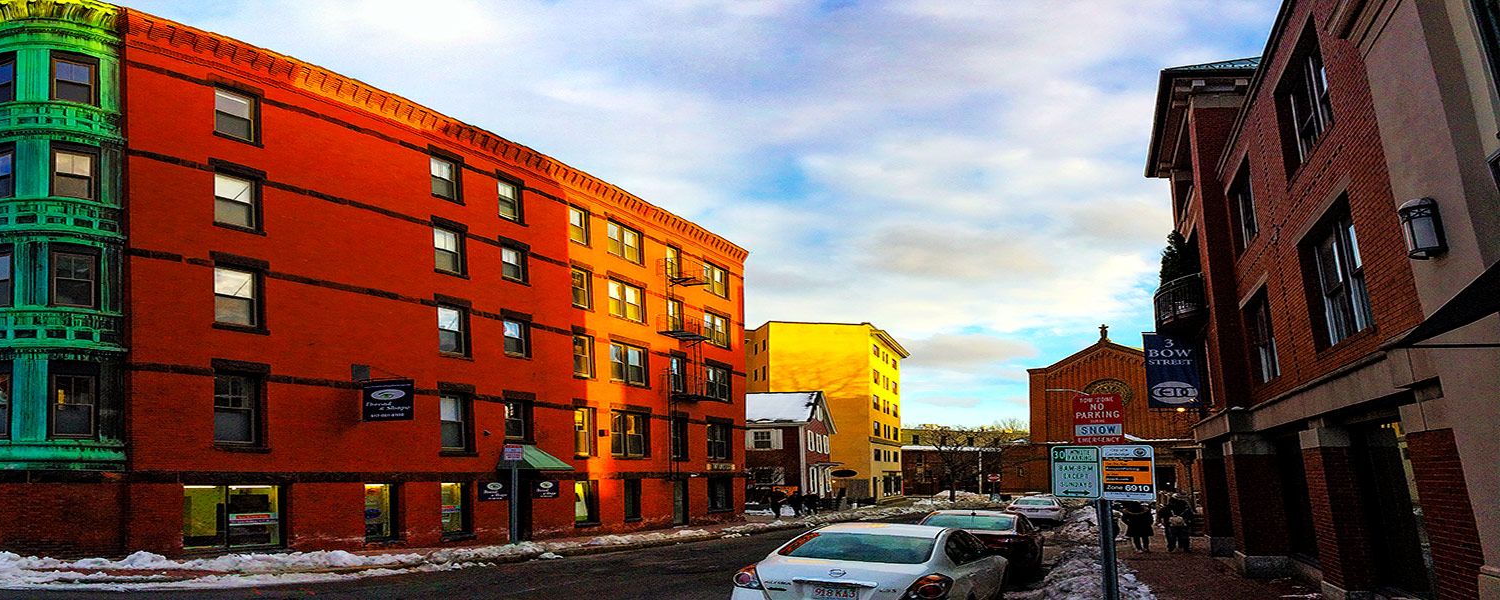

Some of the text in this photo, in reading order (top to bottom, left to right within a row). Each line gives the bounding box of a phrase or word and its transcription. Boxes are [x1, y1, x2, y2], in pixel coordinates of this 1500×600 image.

[1164, 339, 1174, 348] 3
[1148, 349, 1192, 357] BOW
[1076, 410, 1120, 419] PARKING
[1081, 425, 1116, 435] SNOW
[1053, 450, 1066, 460] 30
[1124, 484, 1151, 492] 6910
